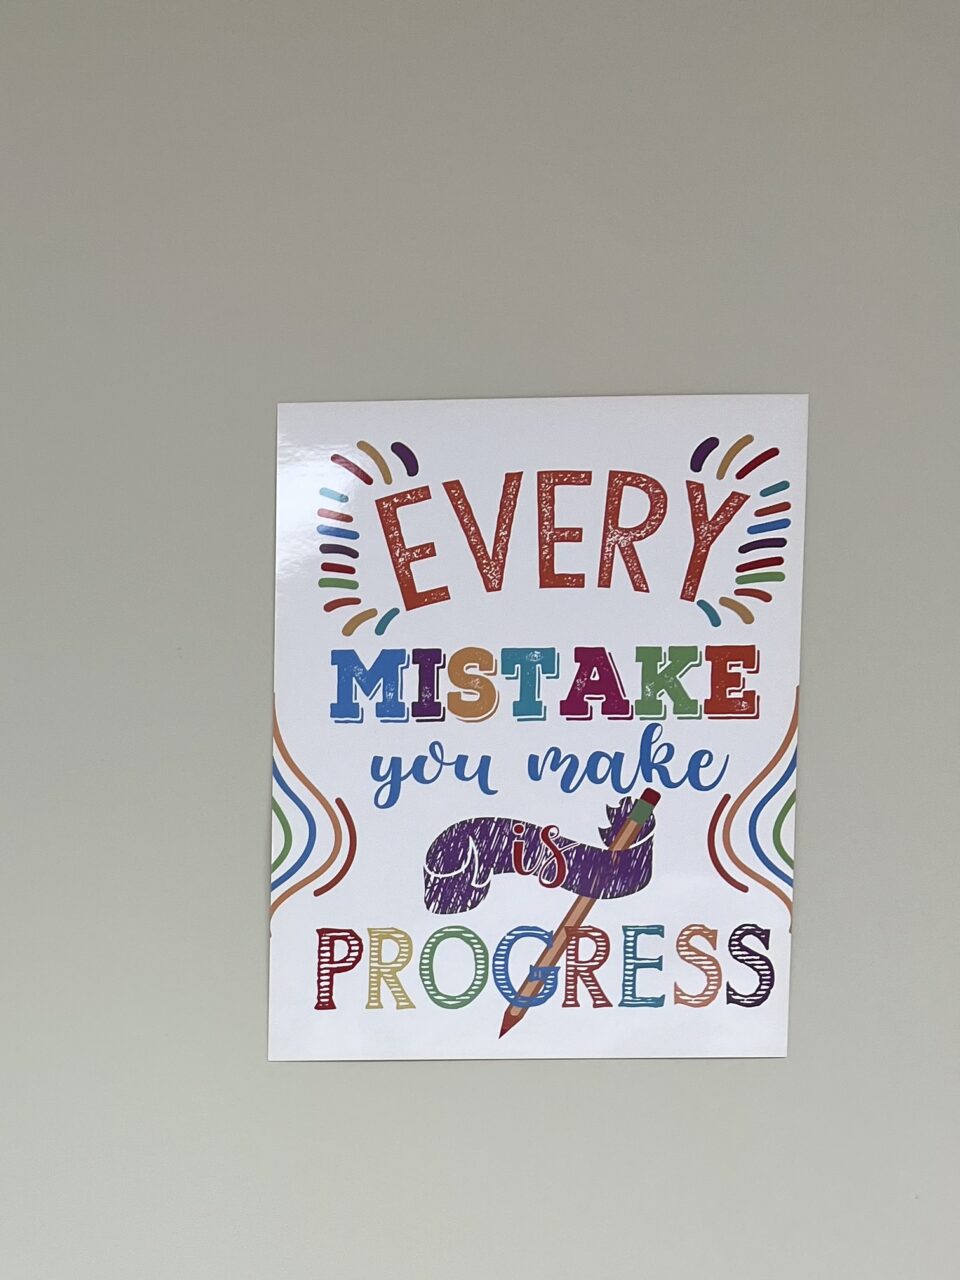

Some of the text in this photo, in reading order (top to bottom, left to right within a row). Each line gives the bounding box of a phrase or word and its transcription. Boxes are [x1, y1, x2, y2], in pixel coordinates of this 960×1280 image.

[375, 470, 751, 612] EVERY
[330, 645, 761, 724] MISTAKE
[370, 723, 731, 808] you make
[512, 823, 568, 889] is
[314, 922, 777, 1011] PROGRESS
